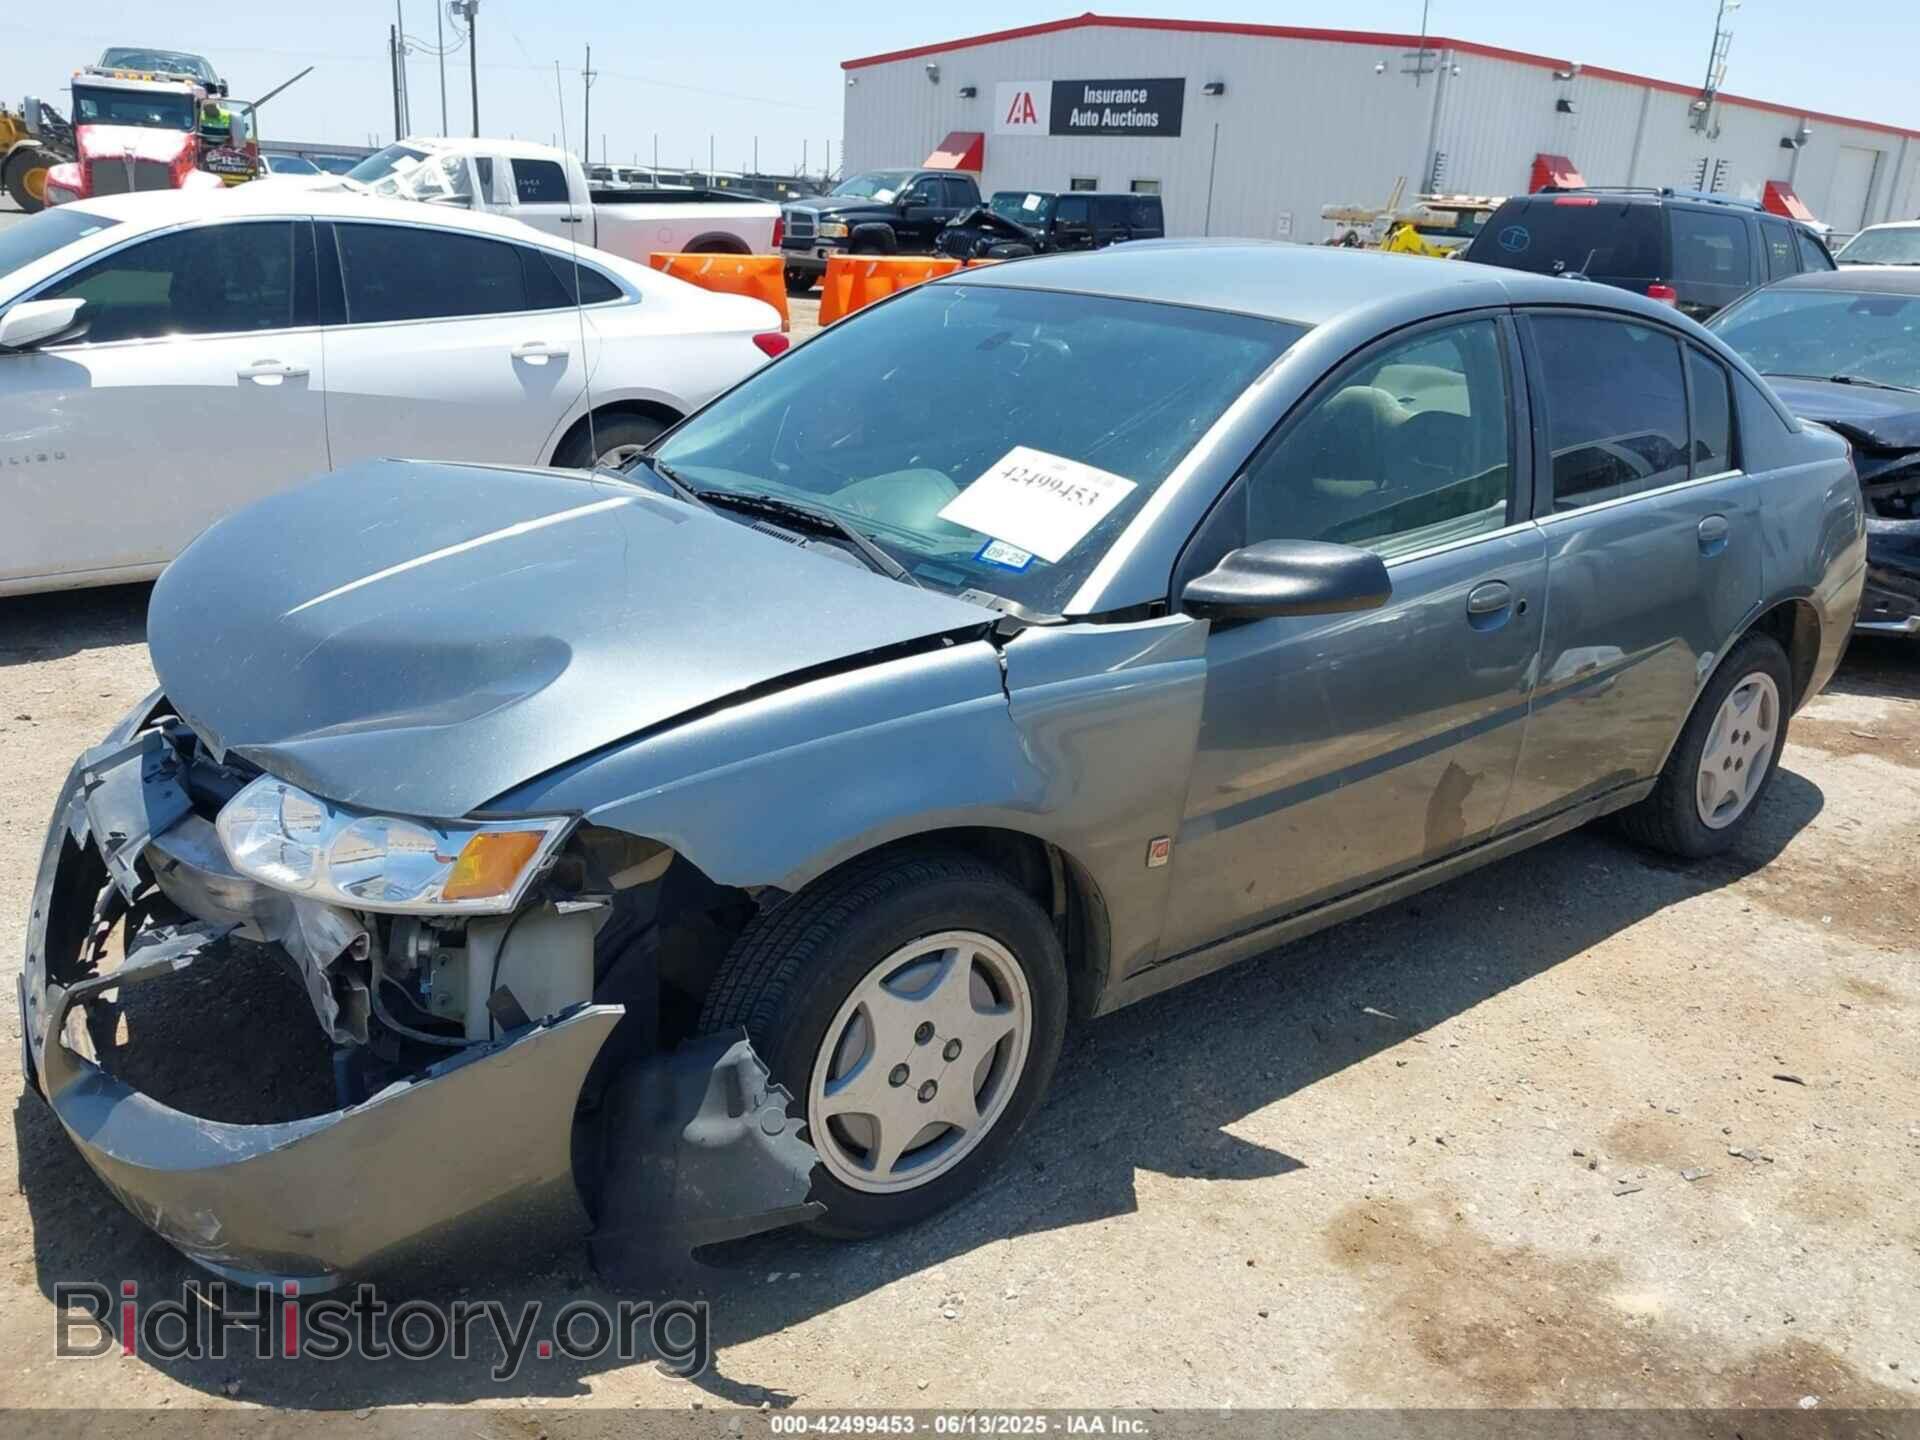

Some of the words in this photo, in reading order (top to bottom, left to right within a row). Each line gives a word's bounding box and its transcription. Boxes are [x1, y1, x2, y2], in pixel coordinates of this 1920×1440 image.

[1083, 85, 1148, 104] Insurance
[1069, 108, 1099, 126] Auto
[1101, 107, 1159, 127] Auctions
[1001, 466, 1100, 506] 42499453
